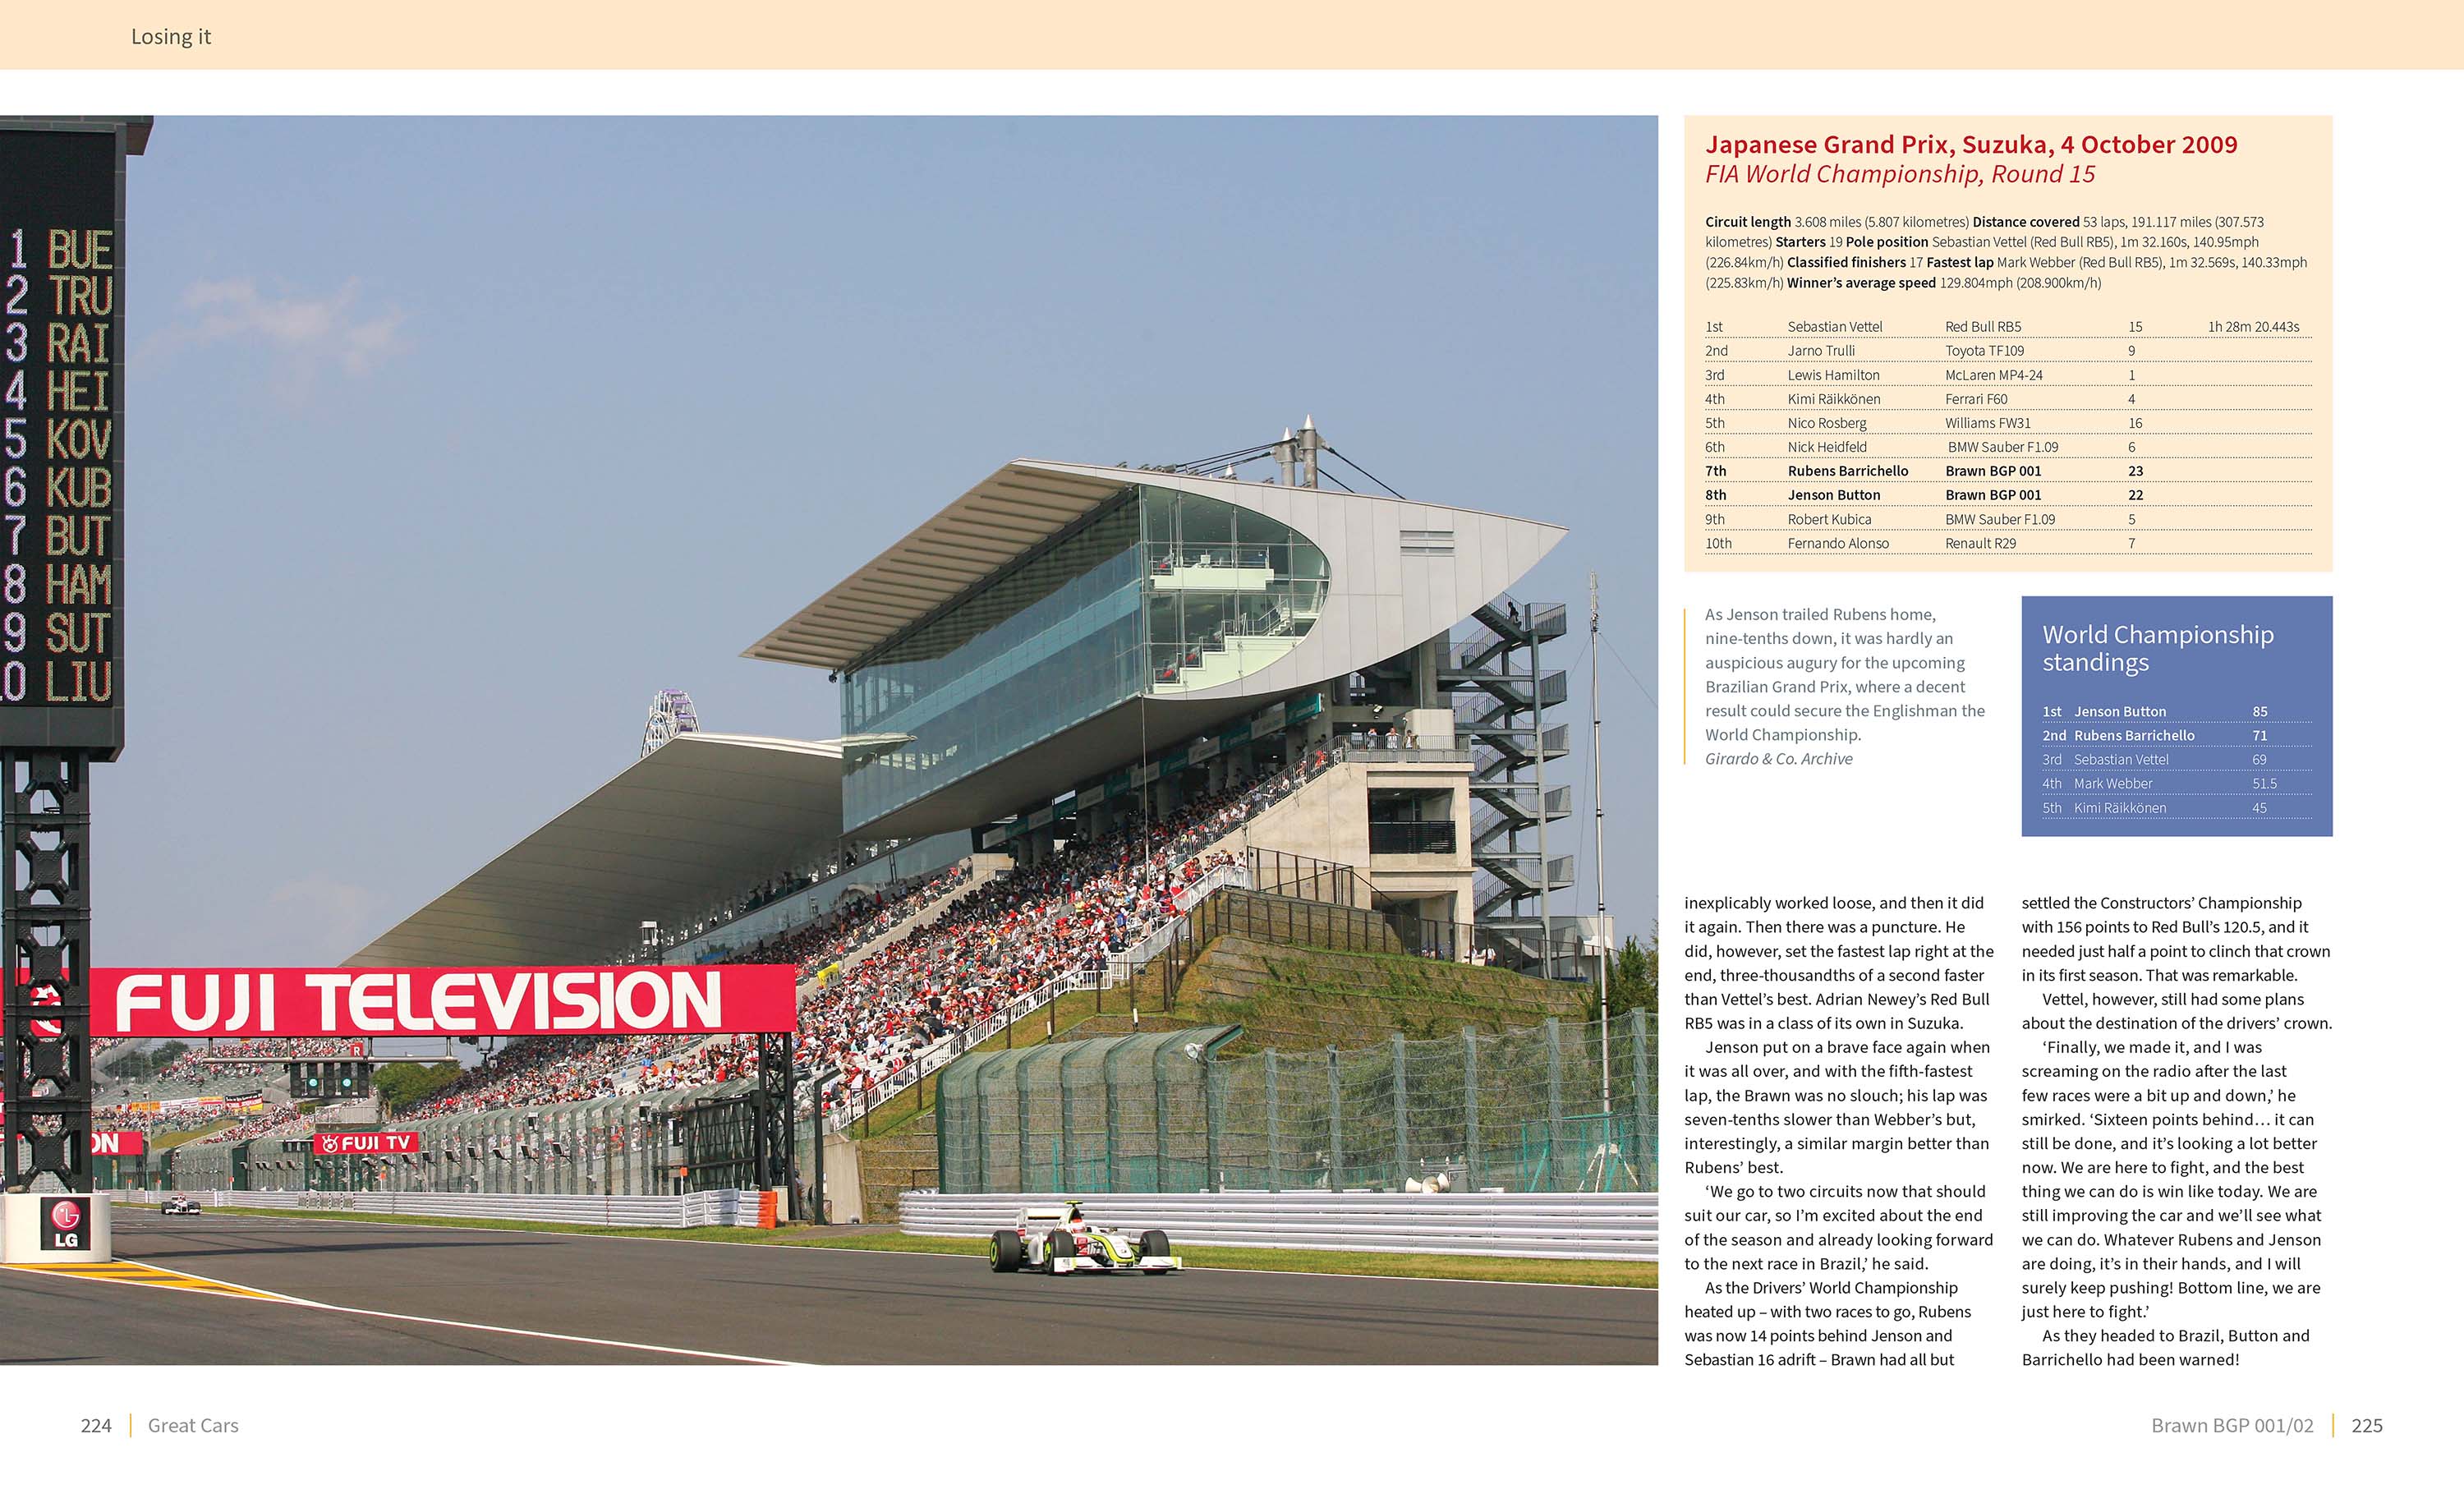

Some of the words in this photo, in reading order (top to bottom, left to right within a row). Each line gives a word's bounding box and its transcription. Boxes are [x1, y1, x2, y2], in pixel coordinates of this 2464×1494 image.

[132, 27, 193, 49] Losing
[199, 27, 212, 45] it
[1705, 135, 1818, 159] Japanese
[1823, 133, 1894, 154] Grand
[1902, 133, 1956, 159] Prix,
[1962, 133, 2055, 159] Suzuka,
[2061, 136, 2076, 154] 4
[2081, 133, 2177, 154] October
[2181, 136, 2238, 154] 2009
[1705, 164, 1739, 184] FIA
[1747, 163, 1812, 183] World
[1817, 163, 1984, 189] Championship,
[1992, 163, 2065, 184] Round
[2069, 164, 2097, 183] 15
[11, 229, 26, 269] 1
[49, 229, 113, 269] BUE
[1706, 276, 1784, 292] (225.83km/h)
[1786, 276, 1843, 289] Winner’s
[1846, 279, 1896, 292] average
[1898, 276, 1937, 292] speed
[1940, 276, 2013, 292] 129.804mph
[2016, 276, 2102, 292] (208.900km/h)
[7, 274, 28, 315] 2
[49, 275, 113, 315] TRU
[1706, 321, 1724, 333] 1st
[1787, 319, 1847, 333] Sebastian
[1849, 319, 1883, 333] Vettel
[1946, 320, 1968, 333] Red
[1971, 319, 1995, 333] Bull
[1997, 320, 2022, 333] RB5
[2129, 320, 2143, 333] 15
[2209, 320, 2223, 333] 1h
[2225, 320, 2252, 333] 28m
[2255, 320, 2301, 333] 20.443s
[7, 322, 27, 362] 3
[48, 323, 108, 362] RAI
[1705, 344, 1728, 356] 2nd
[1787, 345, 1823, 356] Jarno
[1826, 344, 1855, 356] Trulli
[1945, 344, 1986, 360] Toyota
[1988, 345, 2025, 356] TF109
[2128, 344, 2135, 356] 9
[1705, 368, 1725, 381] 3rd
[1788, 369, 1823, 381] Lewis
[1825, 368, 1880, 381] Hamilton
[1946, 369, 1996, 381] McLaren
[1999, 369, 2043, 381] MP4-24
[2129, 370, 2135, 381] 1
[6, 370, 26, 410] 4
[48, 370, 108, 411] HEI
[1705, 416, 1726, 430] 5th
[1788, 416, 1816, 429] Nico
[1818, 416, 1868, 431] Rosberg
[1945, 416, 1996, 429] Williams
[1999, 417, 2031, 429] FW31
[2129, 417, 2143, 429] 16
[5, 418, 26, 458] 5
[48, 418, 111, 459] KOV
[1705, 464, 1727, 477] 7th
[1788, 464, 1837, 477] Rubens
[1839, 464, 1910, 477] Barrichello
[1946, 465, 1986, 477] Brawn
[1990, 465, 2016, 477] BGP
[2019, 465, 2042, 477] 001
[2128, 465, 2144, 477] 23
[5, 467, 26, 507] 6
[47, 467, 111, 508] KUB
[1705, 488, 1727, 501] 8th
[1787, 489, 1834, 501] Jenson
[1837, 489, 1881, 501] Button
[1946, 489, 1986, 501] Brawn
[1990, 489, 2016, 501] BGP
[2019, 489, 2042, 501] 001
[2128, 489, 2144, 501] 22
[6, 515, 25, 554] 7
[46, 516, 111, 555] BUT
[1706, 536, 1732, 549] 10th
[1788, 536, 1846, 549] Fernando
[1848, 536, 1890, 549] Alonso
[1946, 536, 1992, 549] Renault
[1994, 537, 2017, 549] R29
[2128, 537, 2136, 549] 7
[4, 563, 25, 604] 8
[47, 564, 111, 604] HAM
[4, 612, 25, 652] 9
[47, 613, 111, 653] SUT
[2043, 623, 2108, 644] World
[2114, 623, 2274, 650] Championship
[2043, 651, 2149, 678] standings
[0, 661, 25, 701] 0
[47, 661, 111, 701] LIU
[1706, 679, 1768, 693] Brazilian
[1772, 679, 1816, 693] Grand
[1820, 680, 1852, 696] Prix,
[1855, 679, 1901, 693] where
[1904, 683, 1912, 693] a
[1915, 679, 1966, 693] decent
[2043, 706, 2062, 717] 1st
[2074, 706, 2120, 717] Jenson
[2123, 706, 2167, 717] Button
[2253, 706, 2268, 717] 85
[1705, 727, 1749, 742] World
[1752, 728, 1862, 745] Championship.
[2043, 729, 2066, 742] 2nd
[2075, 729, 2122, 742] Rubens
[2126, 729, 2195, 742] Barrichello
[2253, 729, 2268, 742] 71
[1705, 752, 1759, 765] Girardo
[1762, 752, 1773, 765] &
[1776, 752, 1798, 765] Co.
[1800, 752, 1854, 765] Archive
[2043, 753, 2062, 765] 3rd
[2075, 753, 2132, 765] Sebastian
[2135, 753, 2169, 765] Vettel
[2252, 754, 2267, 765] 69
[2043, 777, 2062, 789] 4th
[2075, 777, 2104, 789] Mark
[2106, 777, 2154, 789] Webber
[2253, 778, 2278, 789] 51.5
[2043, 802, 2062, 814] 5th
[2075, 802, 2101, 814] Kimi
[2104, 802, 2167, 814] Räikkönen
[2252, 802, 2268, 814] 45
[2021, 895, 2071, 910] settled
[2073, 895, 2098, 910] the
[2100, 896, 2195, 910] Constructors’
[2198, 895, 2303, 913] Championship
[116, 973, 275, 1032] FUJI
[305, 970, 722, 1031] TELEVISION
[342, 1136, 379, 1151] FUJI
[386, 1136, 411, 1150] TV
[1685, 1160, 1744, 1175] Rubens’
[1748, 1160, 1784, 1175] best.
[55, 1233, 78, 1248] LG
[2022, 1352, 2103, 1367] Barrichello
[2107, 1352, 2135, 1367] had
[2139, 1353, 2176, 1367] been
[2178, 1353, 2240, 1367] warned!
[80, 1418, 113, 1433] 224
[149, 1418, 196, 1433] Great
[200, 1418, 239, 1433] Cars
[2153, 1418, 2208, 1433] Brawn
[2213, 1418, 2250, 1433] BGP
[2255, 1418, 2314, 1437] 001/02
[2351, 1418, 2384, 1433] 225
